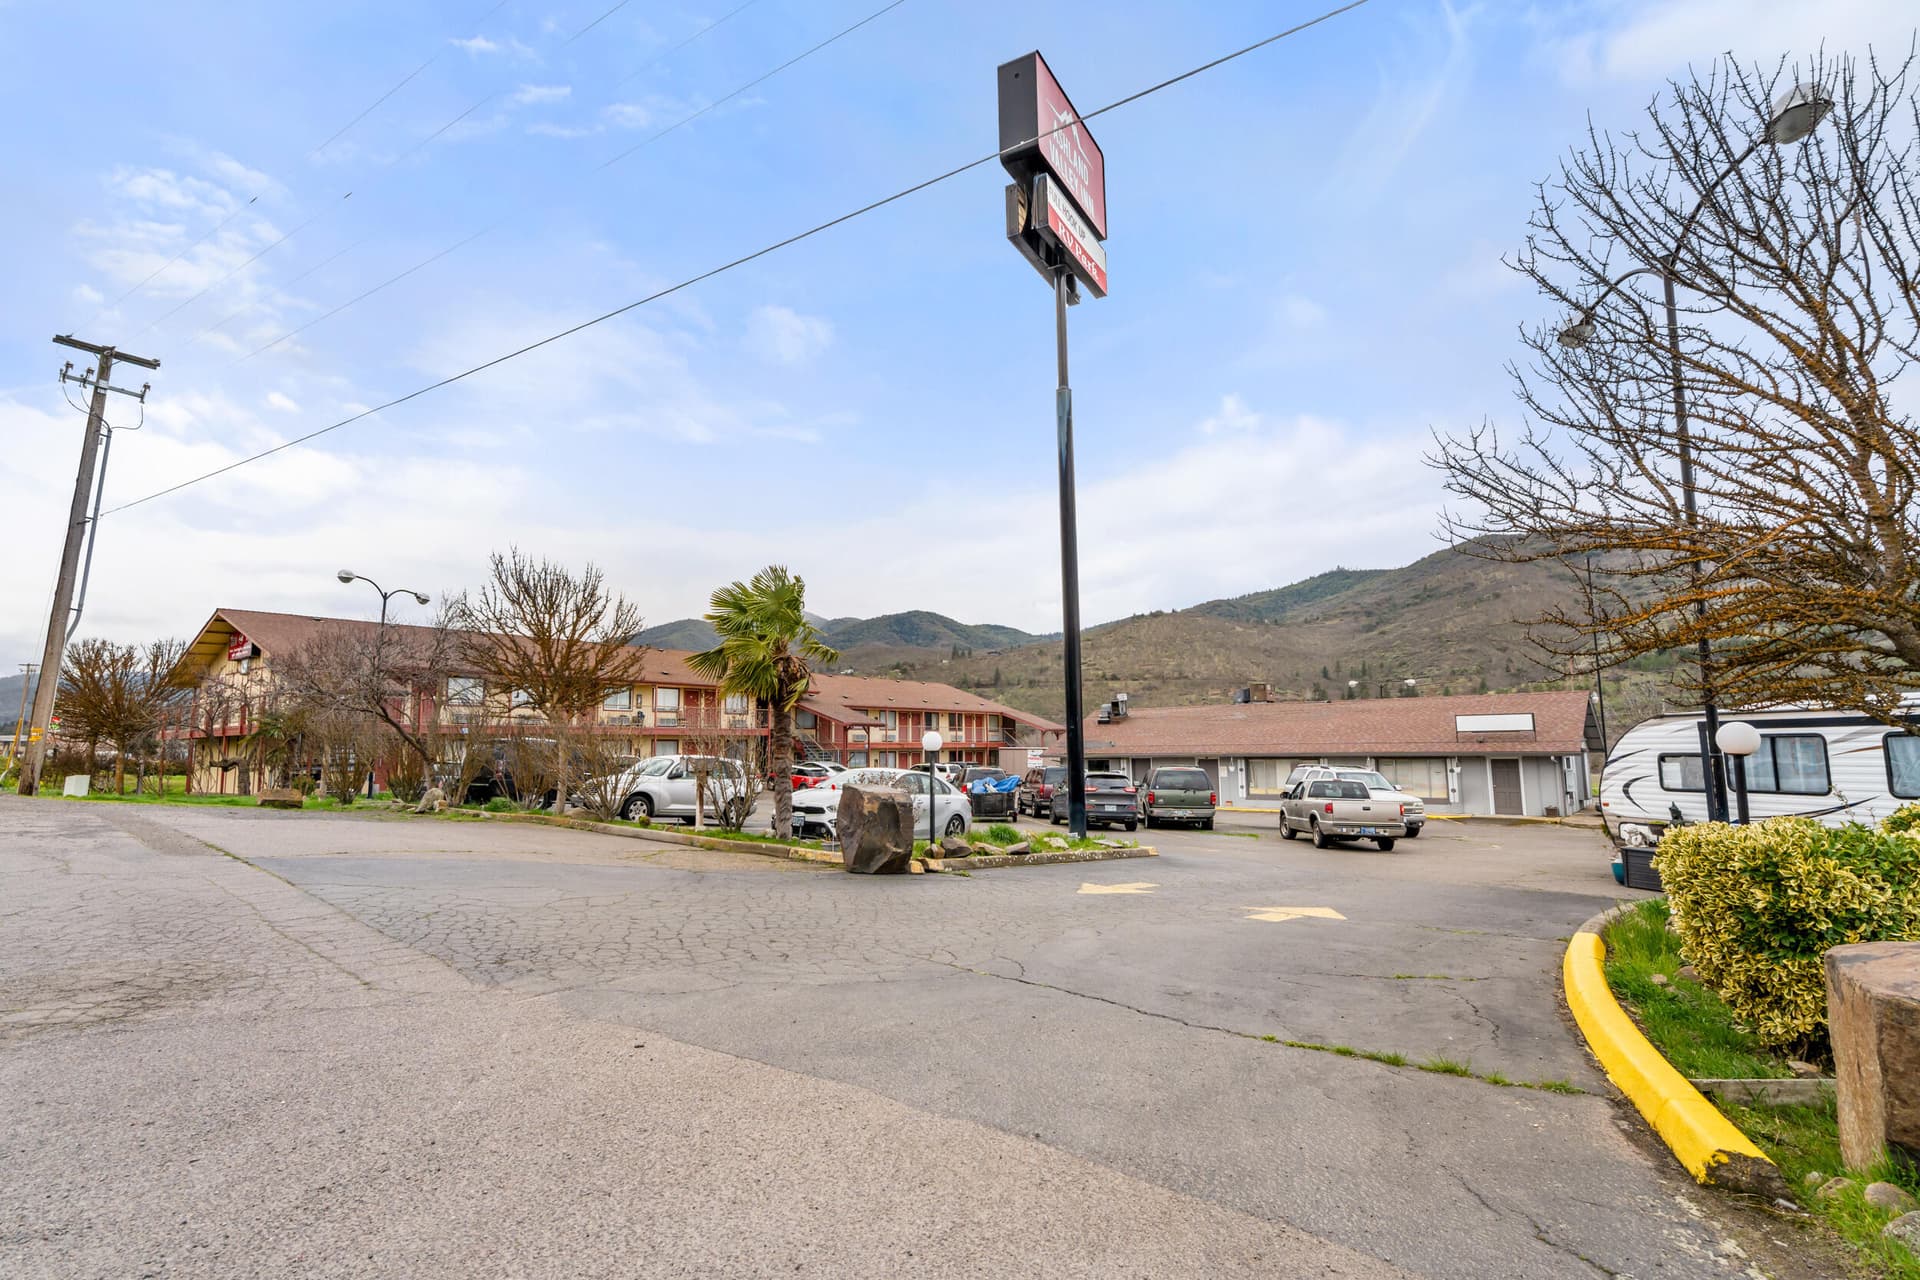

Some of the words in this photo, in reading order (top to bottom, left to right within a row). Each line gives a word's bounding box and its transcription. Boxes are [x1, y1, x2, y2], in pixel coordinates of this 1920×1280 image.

[1049, 139, 1078, 196] VALLEY
[1080, 184, 1095, 220] INN
[1053, 120, 1088, 185] ASHLAND
[1048, 186, 1061, 211] FULL
[1062, 206, 1077, 229] HOOK
[1078, 226, 1086, 240] UP
[1058, 222, 1073, 247] RV
[1075, 246, 1098, 280] Park
